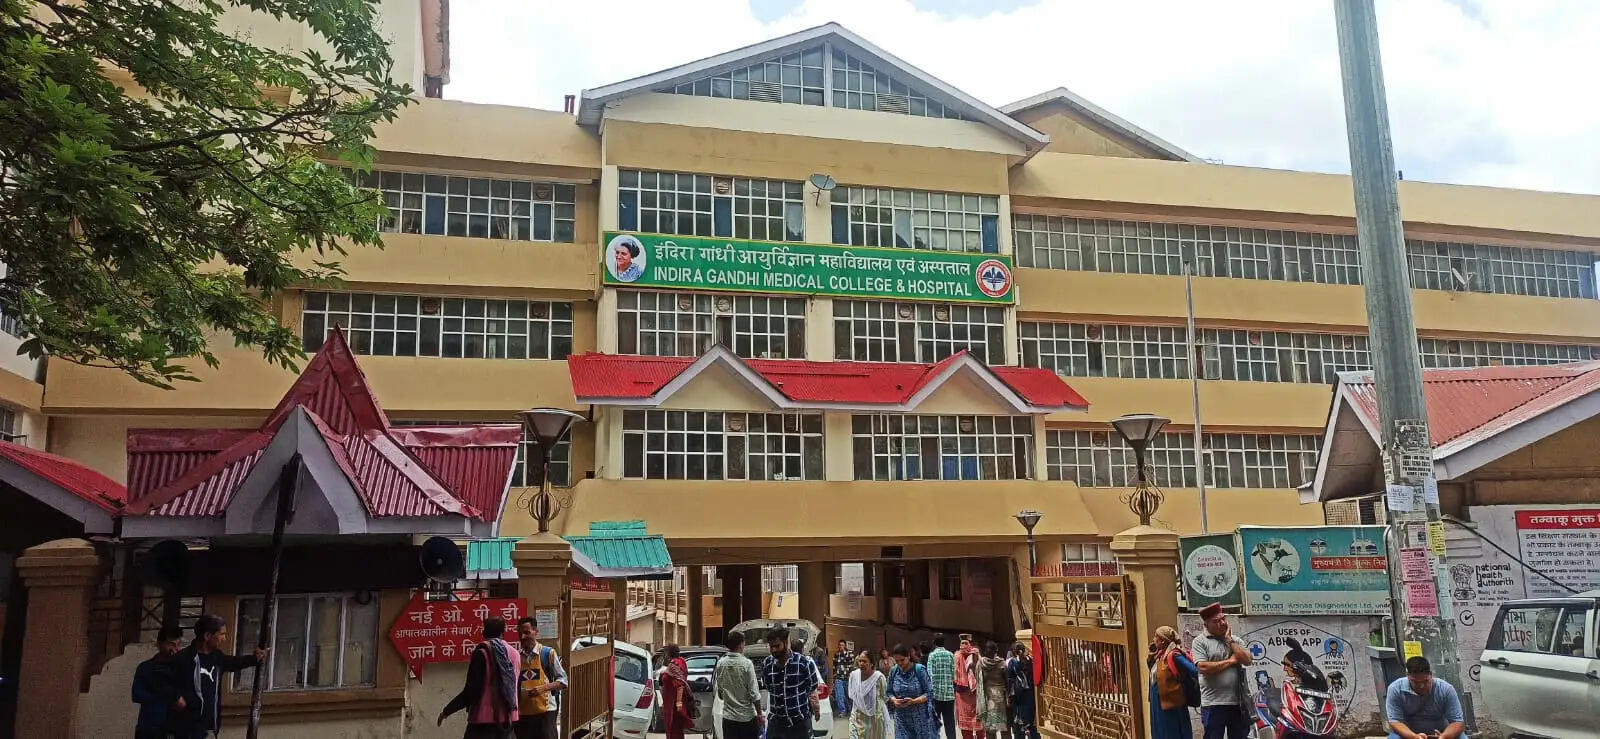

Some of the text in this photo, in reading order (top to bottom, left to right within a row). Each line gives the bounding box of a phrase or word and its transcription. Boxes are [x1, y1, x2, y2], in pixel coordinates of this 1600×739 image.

[654, 240, 971, 276] इंदिरा गांधी आयुर्विज्ञान महाविद्यालय एवं अस्पताल
[654, 267, 972, 297] INDIRA GANDHI MEDICAL COLLEGE & HOSPITAL
[409, 606, 434, 625] नई
[396, 626, 447, 639] आपातकालीन
[1278, 628, 1311, 636] USES OF
[408, 641, 436, 660] जाने
[441, 640, 457, 657] के
[1302, 637, 1322, 647] APP
